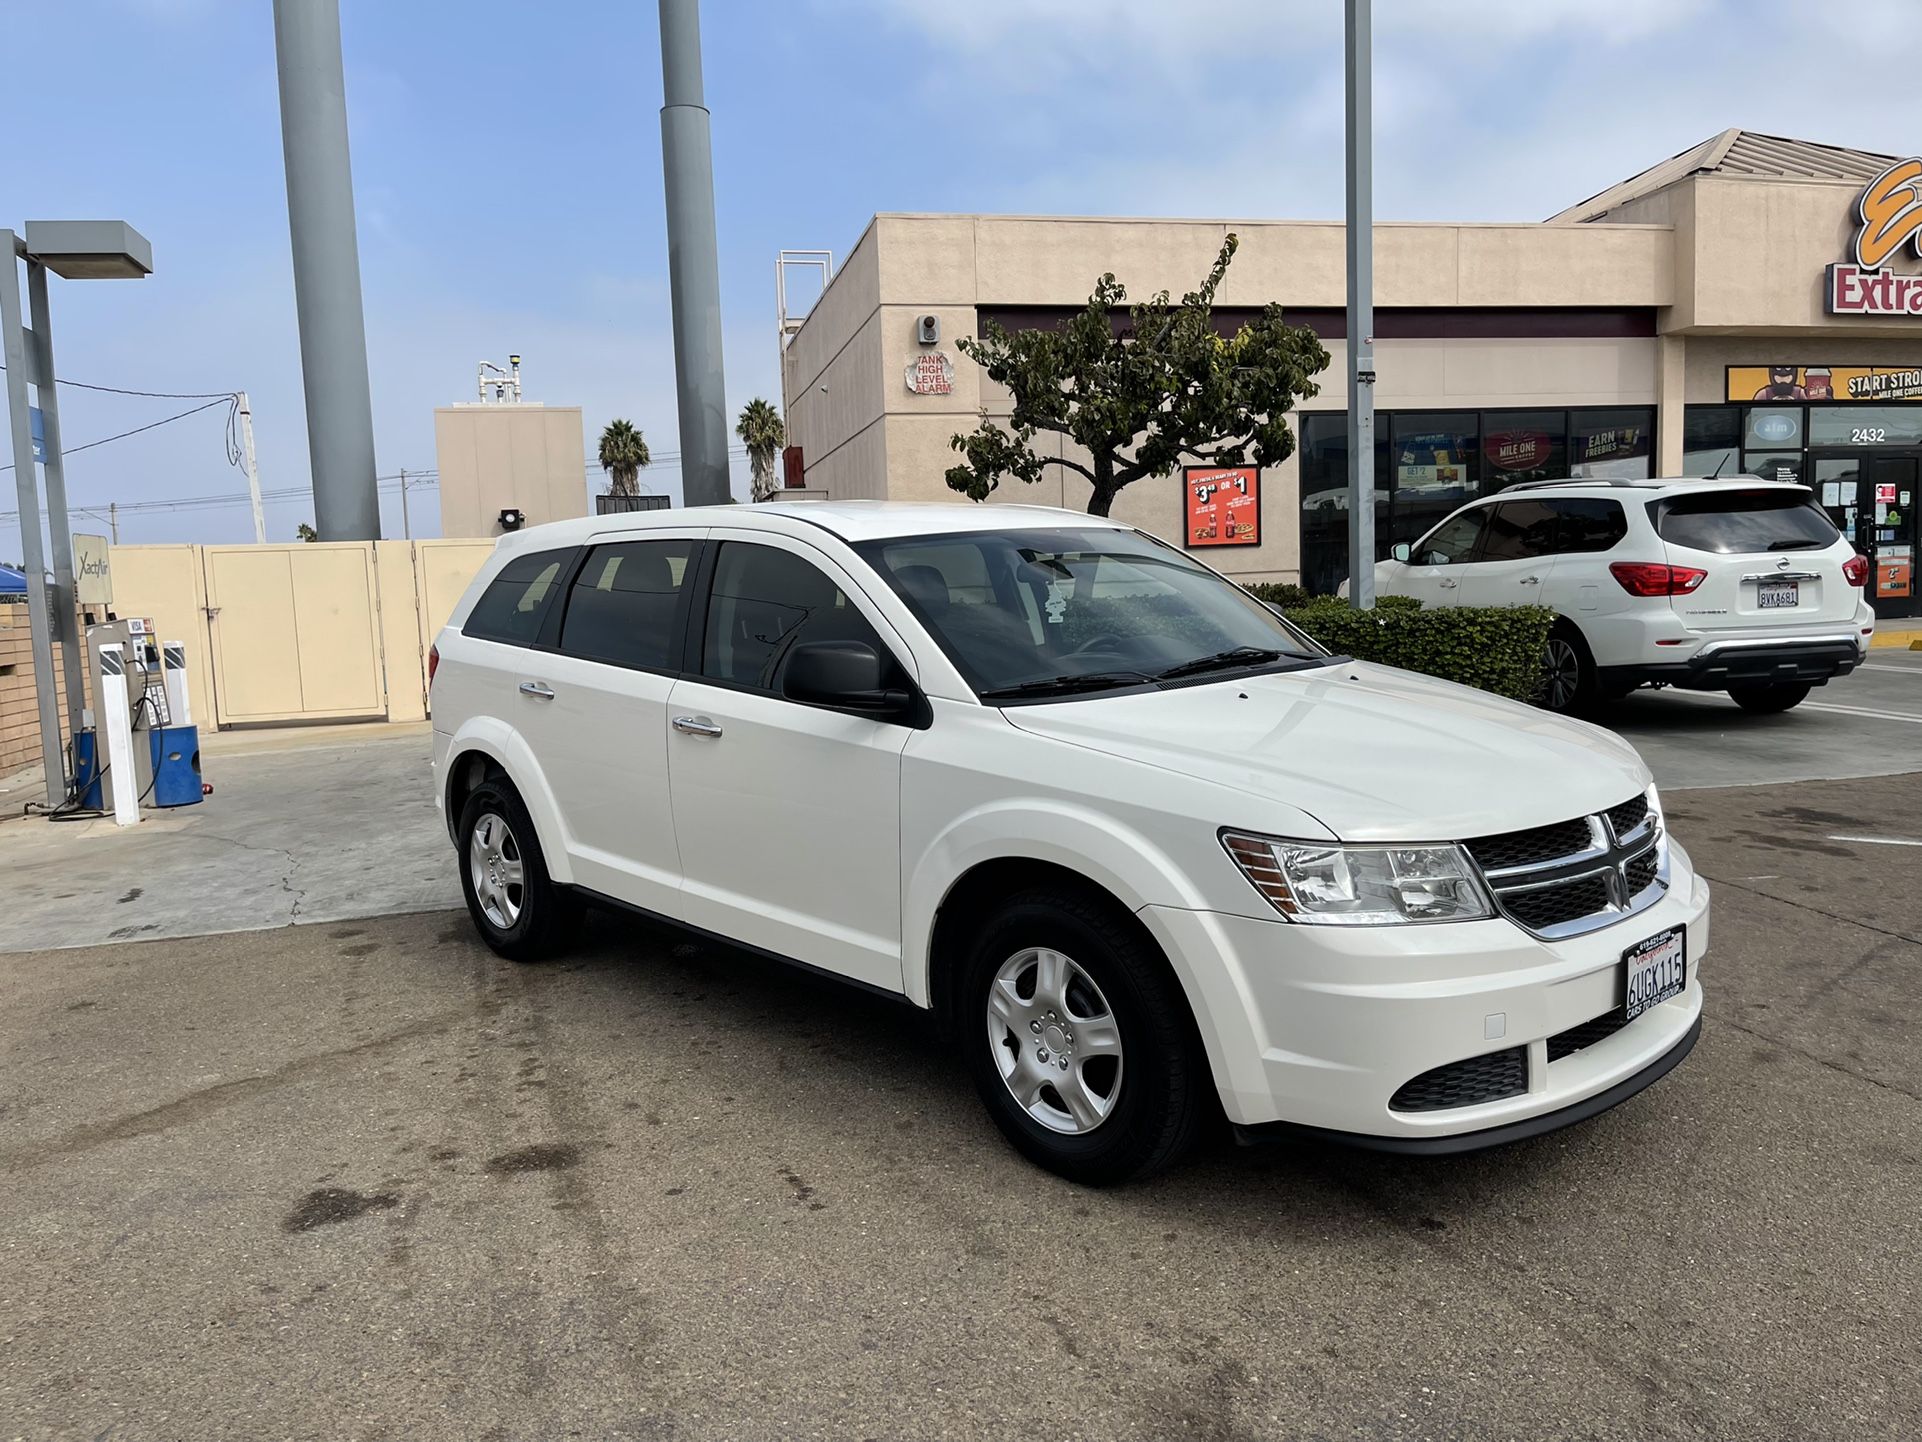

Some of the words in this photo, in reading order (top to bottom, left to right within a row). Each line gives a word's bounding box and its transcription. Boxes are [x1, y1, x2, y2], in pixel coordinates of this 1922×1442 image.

[917, 355, 943, 365] TANK
[917, 365, 943, 374] HIGH
[915, 375, 948, 384] LEVEL
[1848, 374, 1887, 393] START
[915, 383, 951, 394] ALARM
[1588, 430, 1616, 448] EARN
[1851, 428, 1885, 442] 2432
[1499, 444, 1518, 457] MILE
[1519, 440, 1536, 453] ONE
[1585, 441, 1617, 458] FREEBIES
[1220, 481, 1231, 490] OR
[1233, 476, 1245, 492] $1
[1760, 592, 1795, 605] 8VKA681
[1628, 952, 1681, 1006] 6UGK115
[1626, 1004, 1642, 1020] CARS
[1642, 999, 1651, 1011] TO
[1651, 994, 1660, 1006] GO
[1659, 984, 1680, 1002] GROUP
